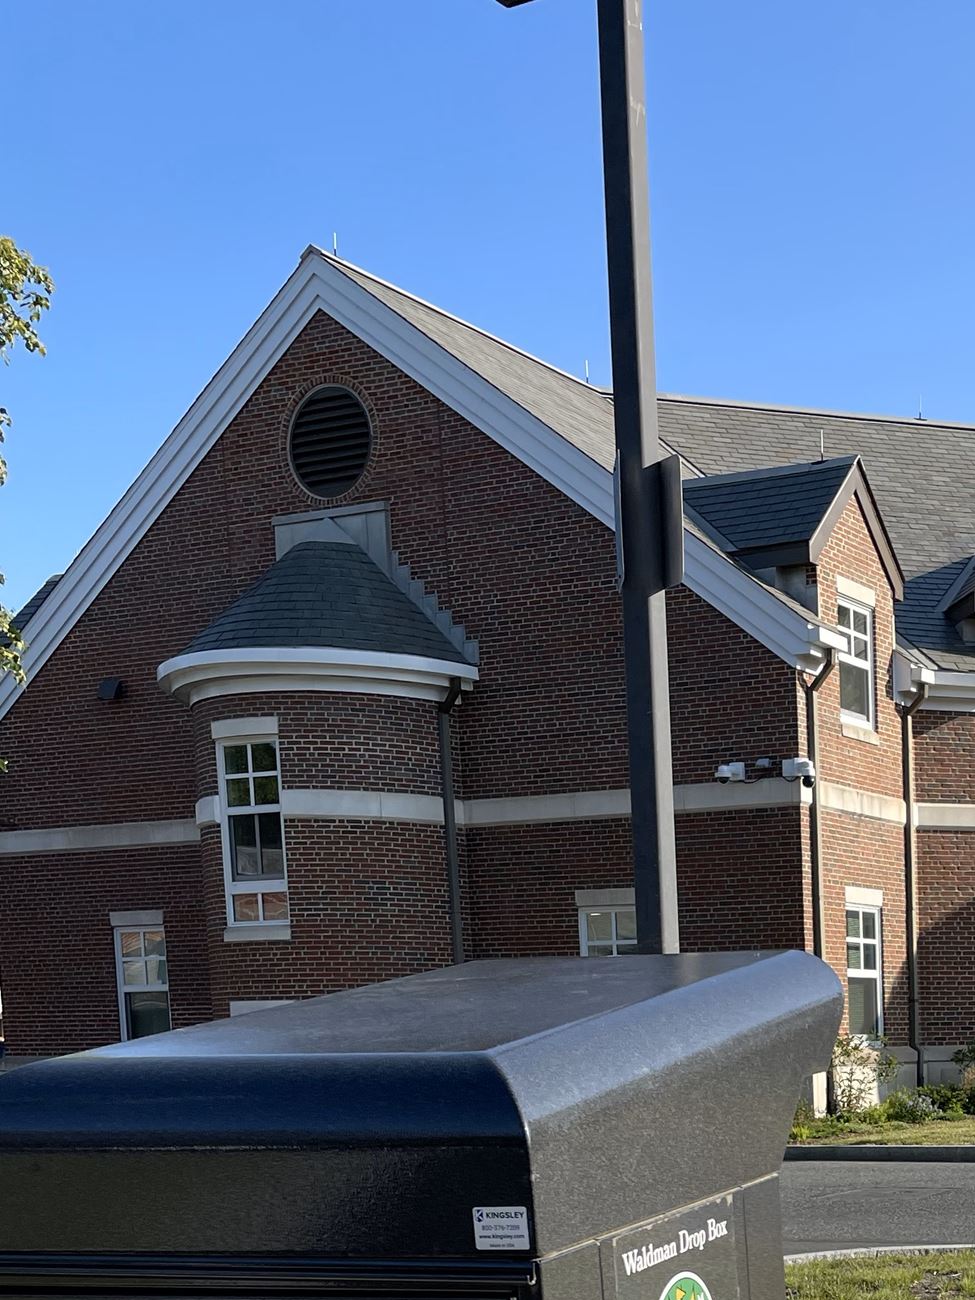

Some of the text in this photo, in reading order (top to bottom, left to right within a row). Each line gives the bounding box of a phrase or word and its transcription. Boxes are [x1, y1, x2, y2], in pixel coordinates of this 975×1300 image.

[486, 1211, 524, 1219] KINGSLEY
[622, 1218, 728, 1276] Waldman Drop Box
